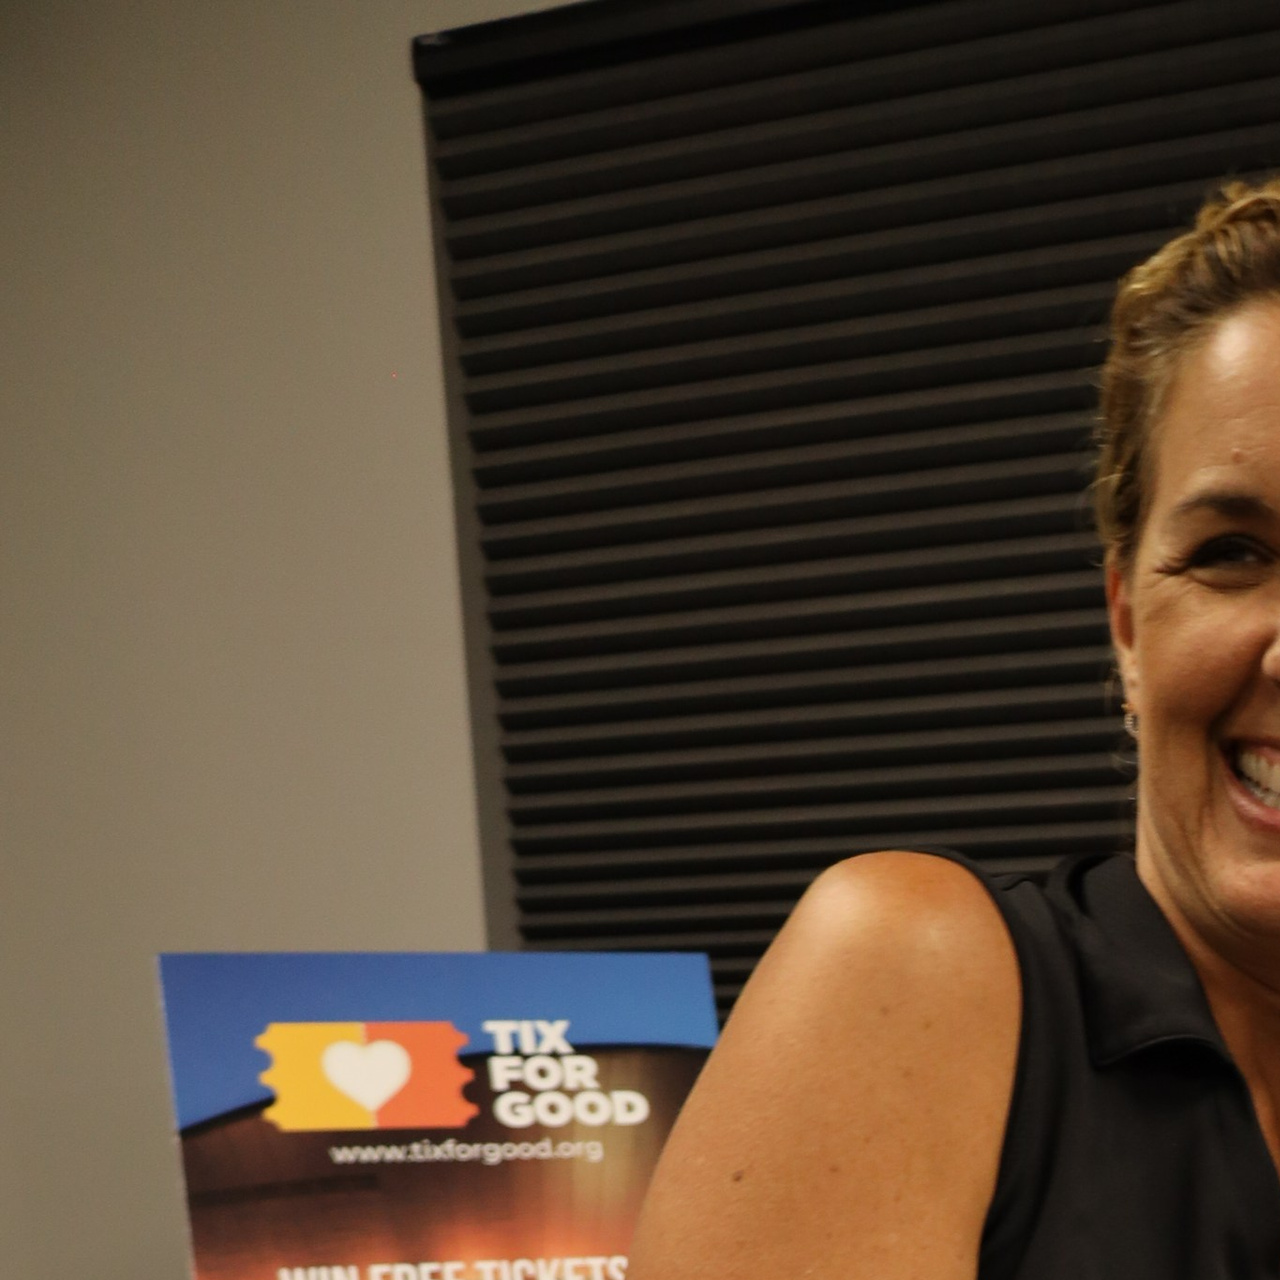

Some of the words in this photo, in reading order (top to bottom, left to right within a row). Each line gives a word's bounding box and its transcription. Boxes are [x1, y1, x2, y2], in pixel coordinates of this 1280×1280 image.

[482, 1019, 575, 1055] TIX
[488, 1055, 600, 1091] FOR
[493, 1090, 650, 1128] GOOD
[330, 1138, 604, 1165] www.tixforgood.org
